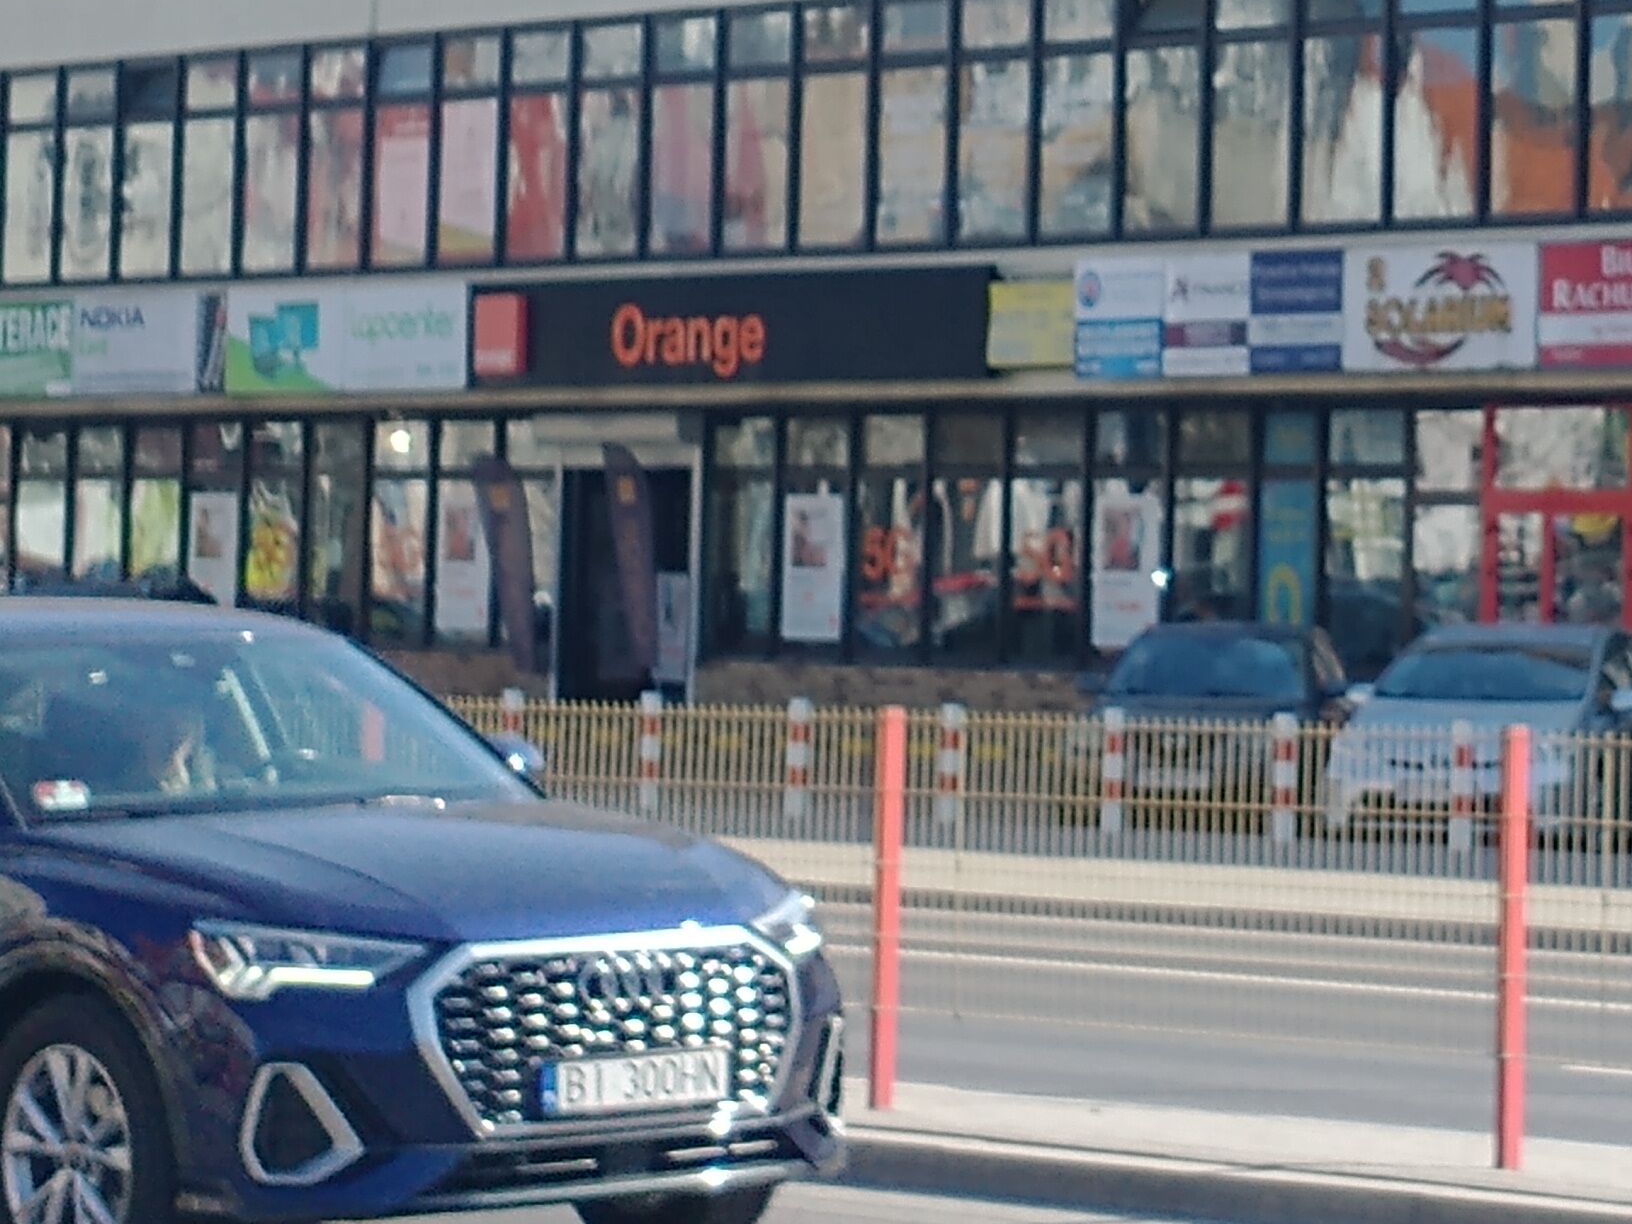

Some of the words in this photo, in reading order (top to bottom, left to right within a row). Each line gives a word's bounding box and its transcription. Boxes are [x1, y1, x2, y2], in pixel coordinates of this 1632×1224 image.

[79, 305, 146, 330] NOKIA
[610, 302, 766, 378] Orange
[565, 1061, 602, 1104] BI
